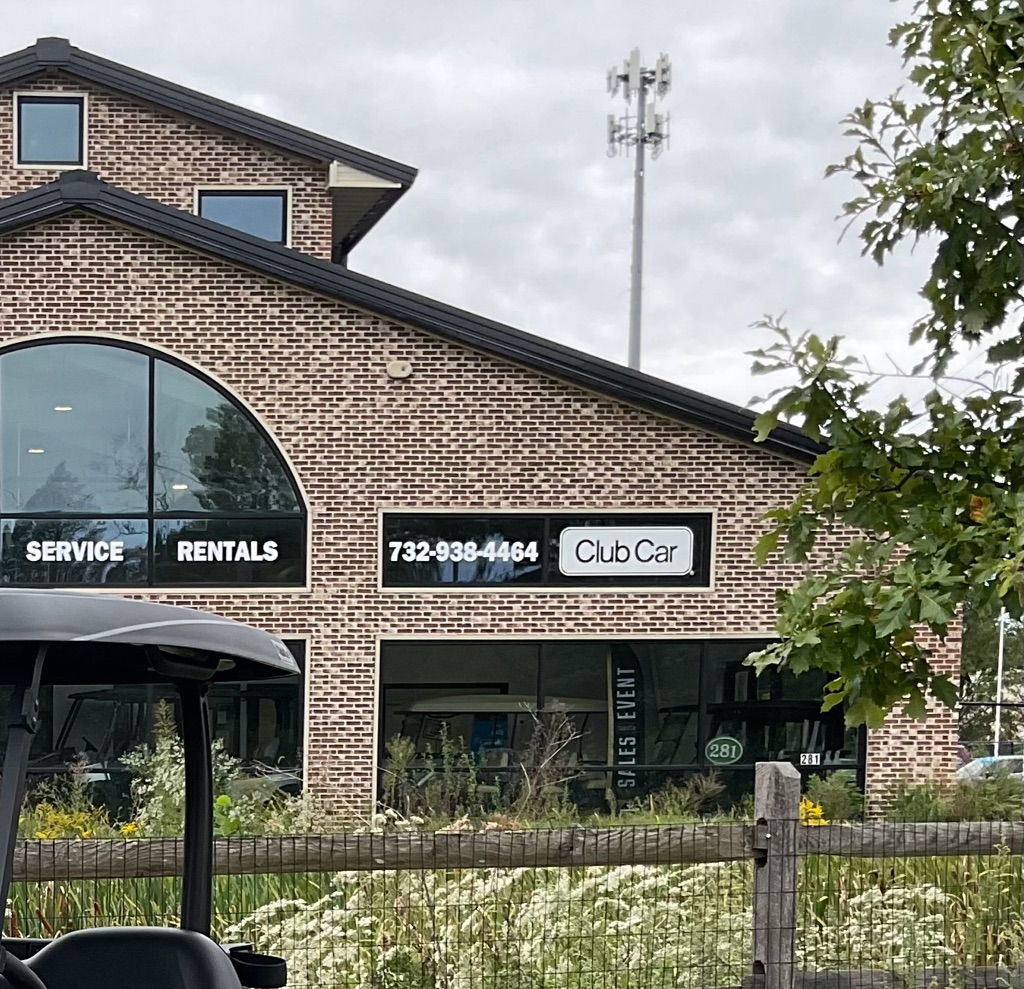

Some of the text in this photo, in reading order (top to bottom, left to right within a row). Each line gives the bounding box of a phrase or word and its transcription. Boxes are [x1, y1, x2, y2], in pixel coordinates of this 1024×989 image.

[26, 540, 124, 562] SERVICE
[177, 540, 278, 562] RENTALS
[388, 541, 538, 562] 732-938-4464
[575, 539, 678, 563] Club Car
[616, 667, 636, 719] EVENT
[709, 743, 736, 758] 281
[801, 754, 819, 765] 281
[617, 737, 636, 788] SALES
